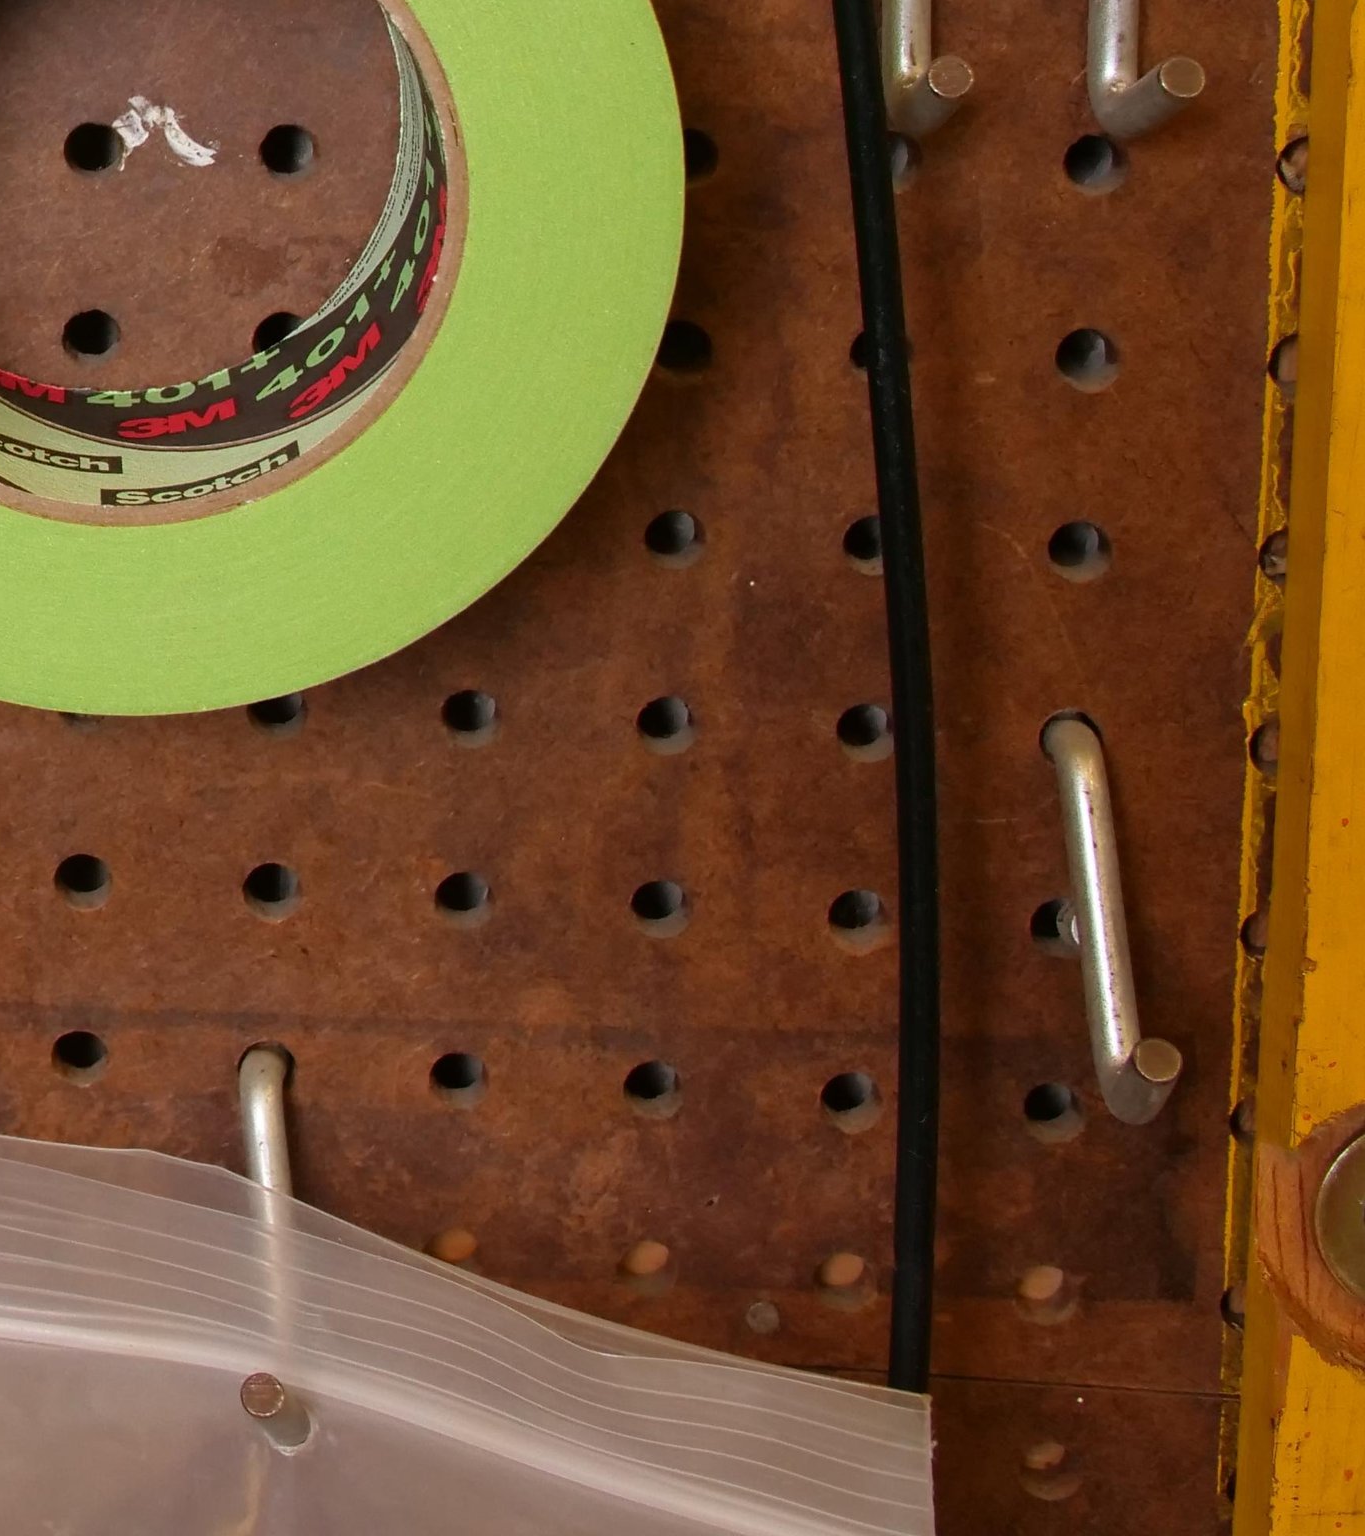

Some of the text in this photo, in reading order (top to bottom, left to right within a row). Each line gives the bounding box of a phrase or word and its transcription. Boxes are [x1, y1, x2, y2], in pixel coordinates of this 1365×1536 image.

[255, 249, 396, 401] 401+
[86, 348, 281, 408] 401+
[288, 322, 382, 418] 3M
[118, 398, 236, 439] 3M
[114, 450, 289, 506] Scotch
